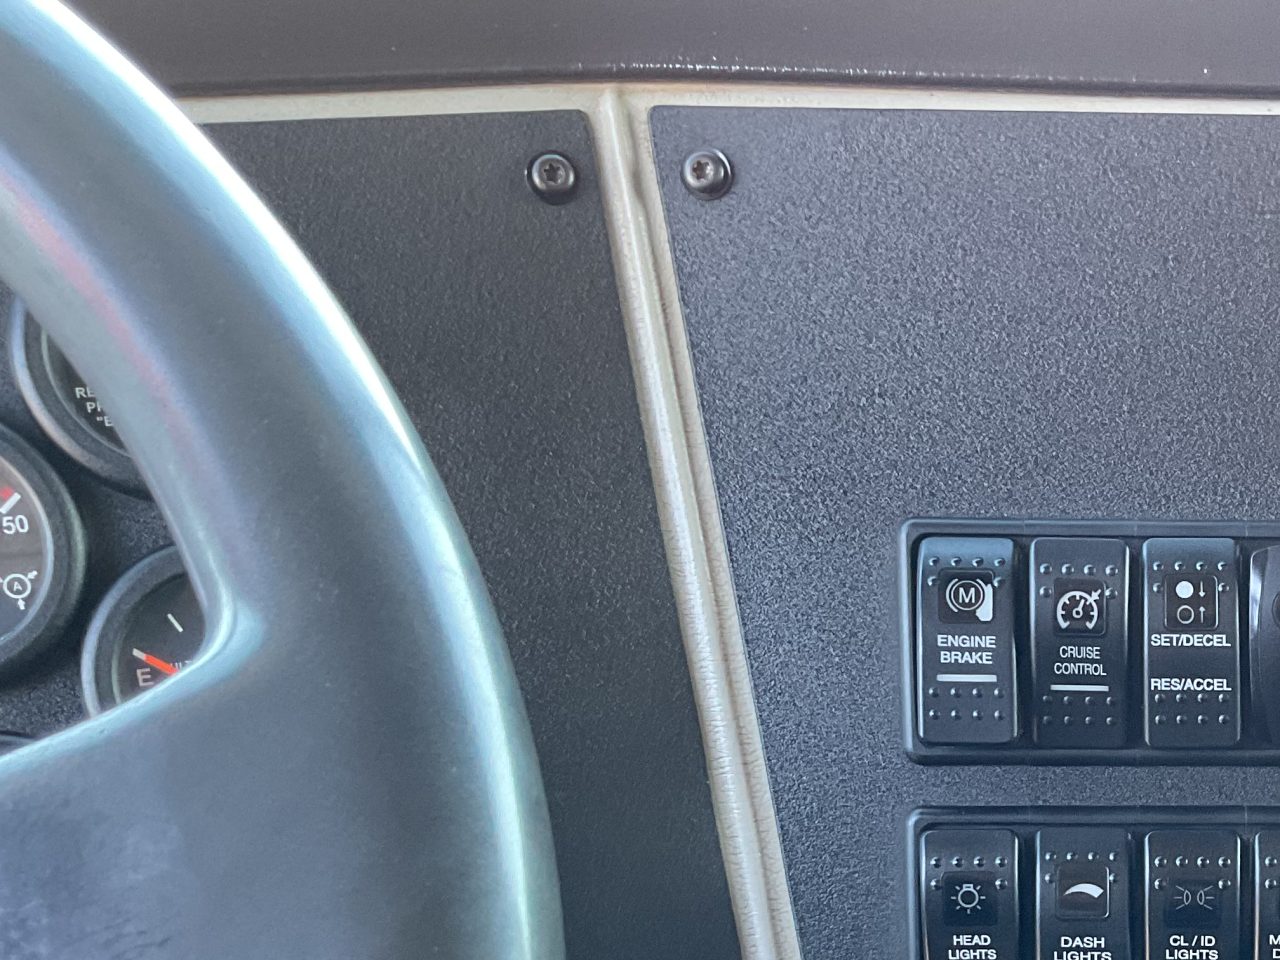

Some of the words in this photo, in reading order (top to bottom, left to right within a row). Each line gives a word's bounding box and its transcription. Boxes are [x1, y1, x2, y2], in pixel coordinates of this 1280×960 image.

[937, 634, 997, 649] ENGINE
[1151, 633, 1232, 647] SET/DECEL
[940, 650, 993, 665] BRAKE
[1059, 645, 1101, 660] CRUISE
[1053, 662, 1107, 676] CONTROL
[136, 668, 154, 686] E
[1151, 678, 1232, 691] RES/ACCEL
[952, 934, 991, 946] HEAD
[1060, 936, 1105, 949] DASH
[1169, 934, 1190, 947] CL
[1200, 935, 1216, 947] ID
[948, 948, 997, 960] LIGHTS
[1165, 948, 1219, 960] LIGHTS
